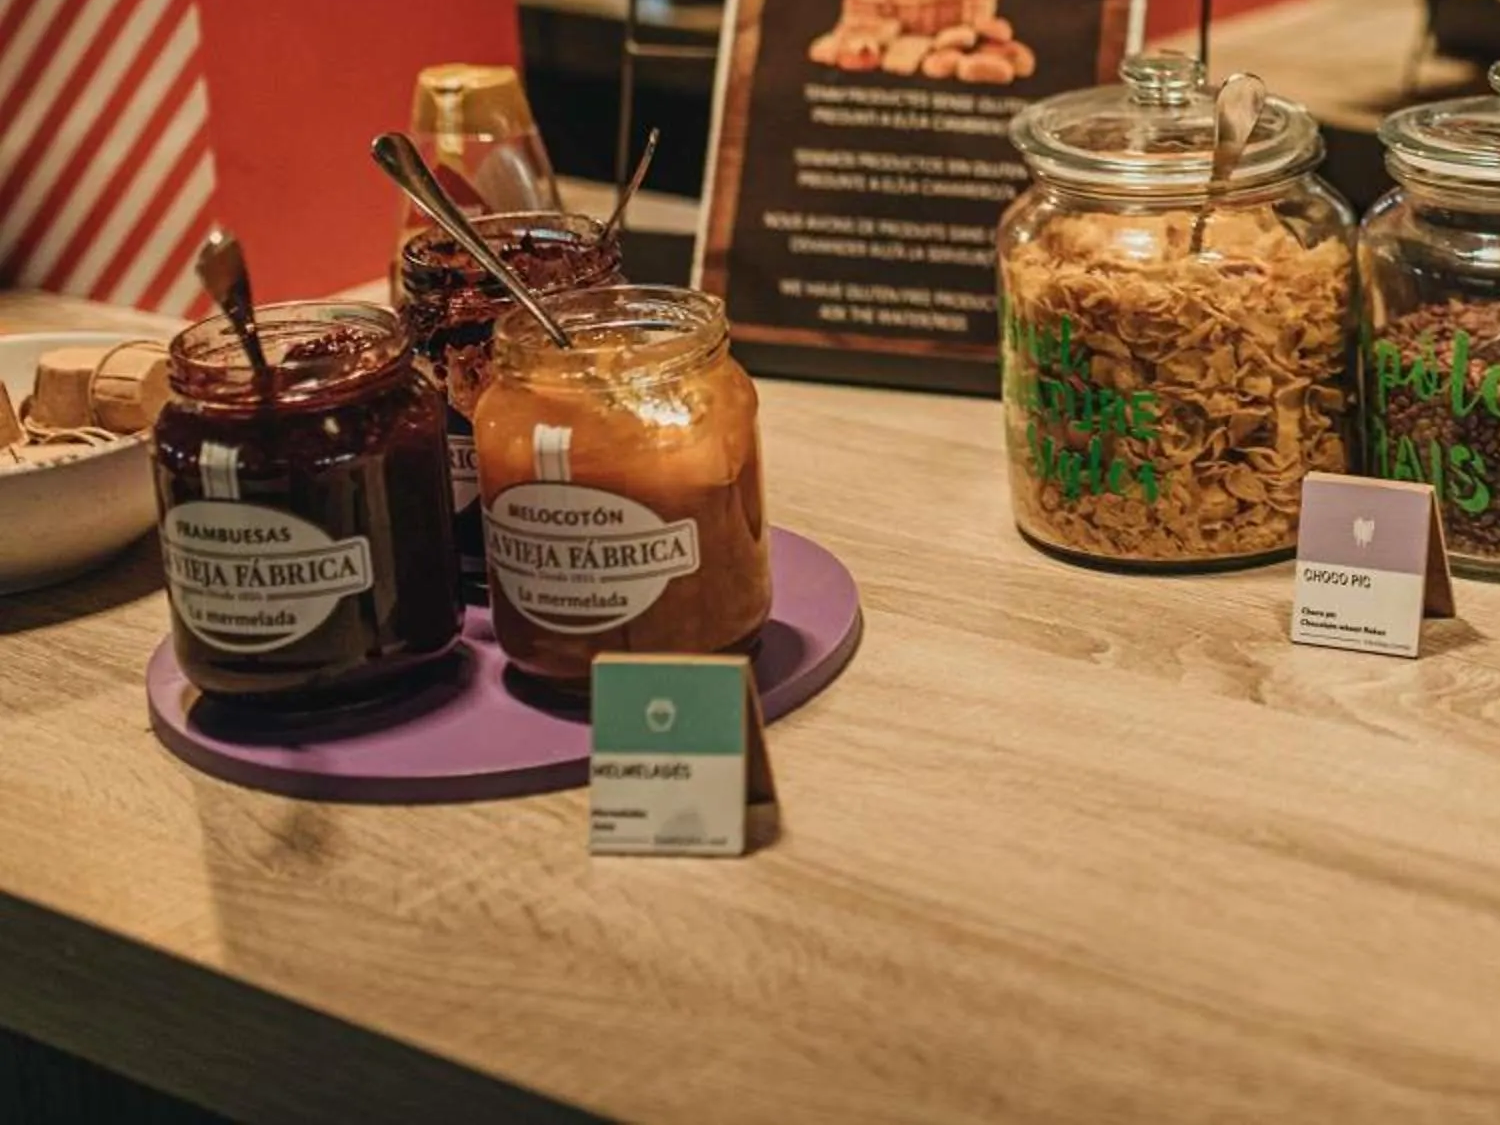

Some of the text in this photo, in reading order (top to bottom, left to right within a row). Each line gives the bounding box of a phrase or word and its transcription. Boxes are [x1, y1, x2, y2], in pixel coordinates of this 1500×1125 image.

[508, 503, 625, 526] MELOCOTÓN
[175, 520, 292, 545] FRAMBUESAS
[502, 537, 562, 571] VIEJA
[567, 535, 688, 571] FÁBRICA
[234, 554, 359, 589] FÁBRICA
[1303, 567, 1349, 587] CHOCO
[518, 586, 630, 609] La mermelada
[206, 607, 297, 628] mermelada
